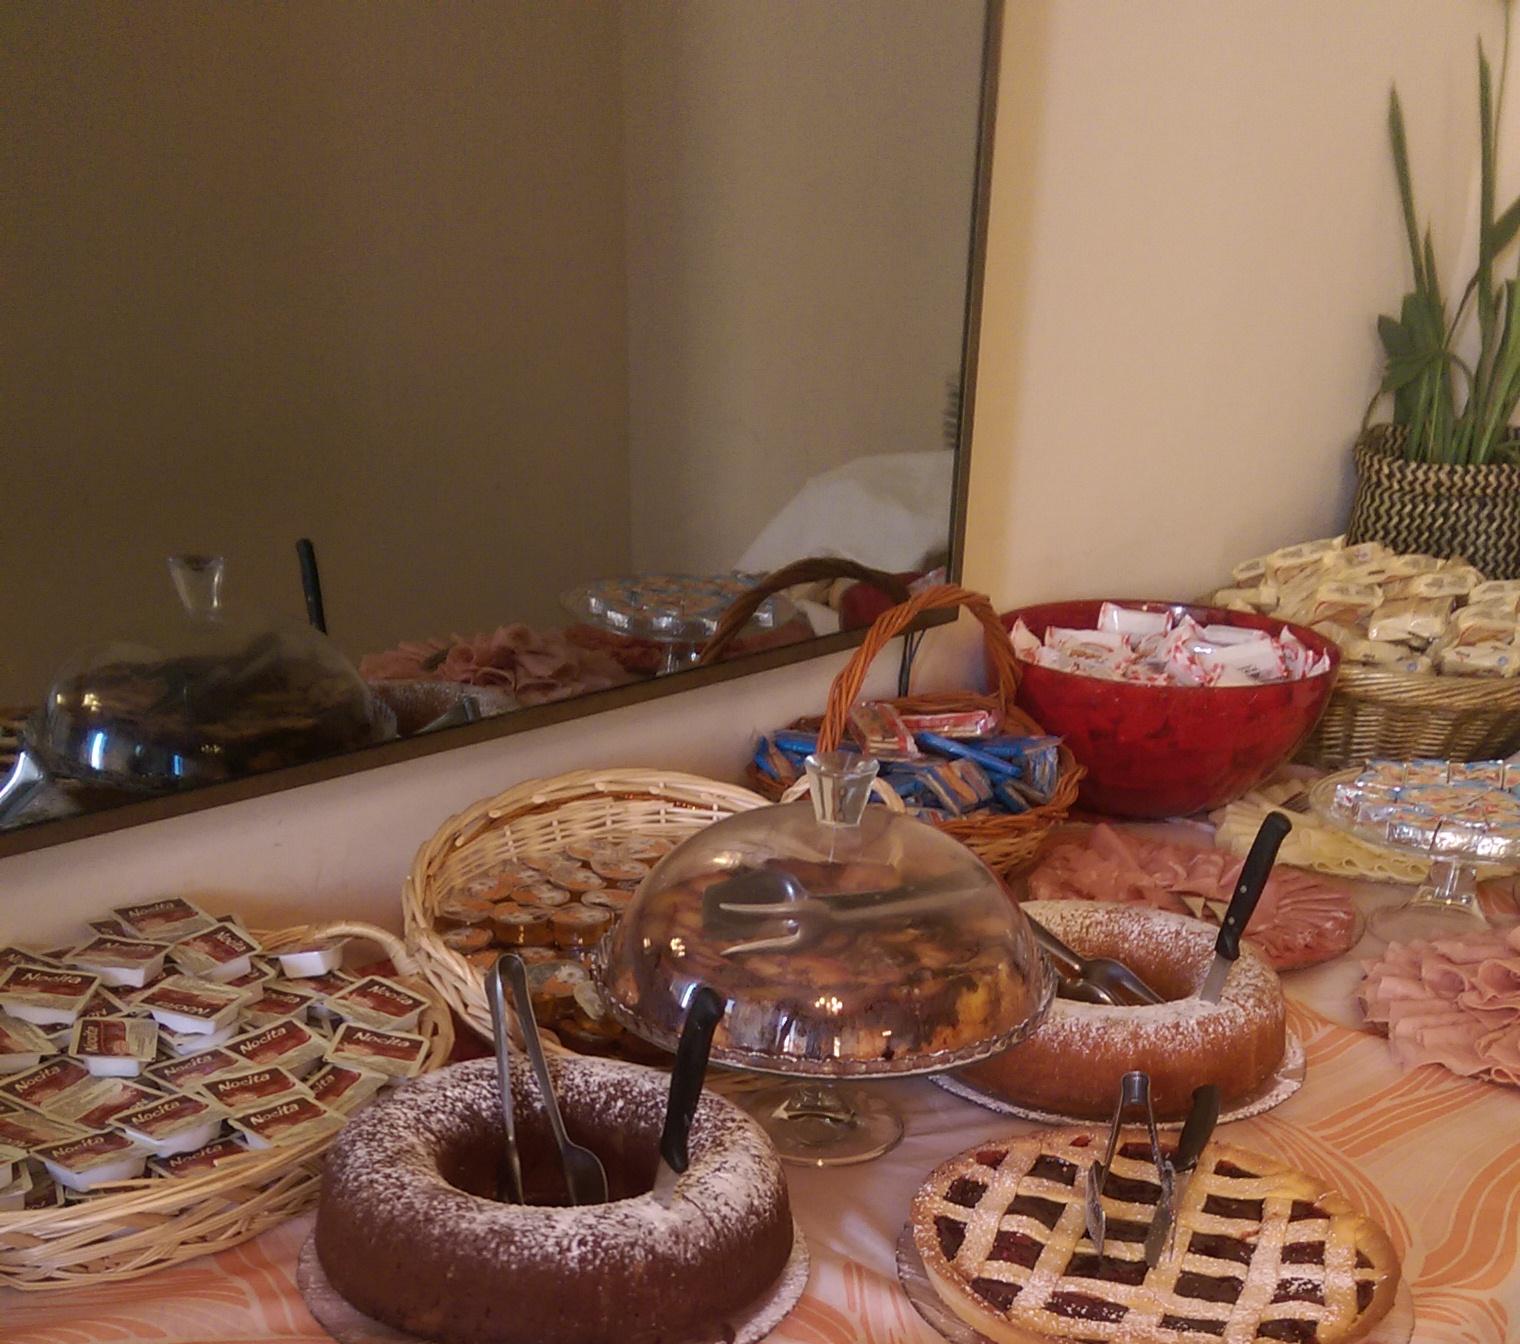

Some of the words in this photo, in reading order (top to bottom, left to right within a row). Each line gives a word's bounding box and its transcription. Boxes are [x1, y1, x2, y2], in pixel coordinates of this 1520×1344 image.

[21, 972, 82, 985] Nocita
[239, 1026, 287, 1055] Nocita
[352, 1031, 411, 1048] Nocita
[163, 1053, 213, 1077] Nocita
[14, 1064, 62, 1094] Nocita
[218, 1071, 271, 1093] Nocita
[131, 1100, 181, 1125] Nocita
[250, 1102, 300, 1127] Nocita
[51, 1135, 105, 1159] Nocita
[169, 1143, 223, 1168] Nocita
